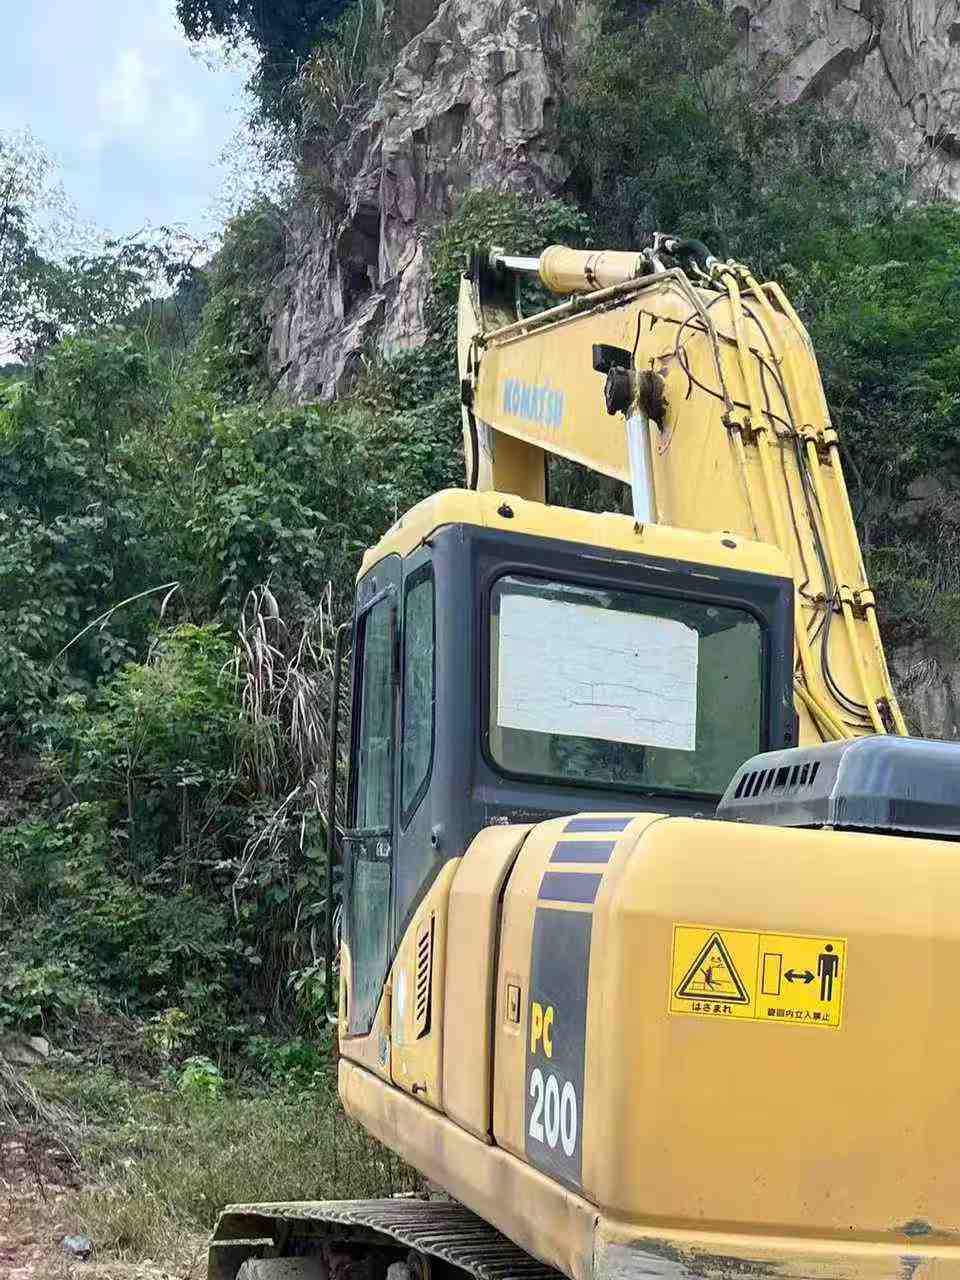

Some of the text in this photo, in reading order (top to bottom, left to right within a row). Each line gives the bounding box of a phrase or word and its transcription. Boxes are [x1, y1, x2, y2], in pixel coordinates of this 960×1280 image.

[503, 377, 563, 427] KOMATSU
[530, 1002, 554, 1058] PC
[529, 1067, 578, 1157] 200
